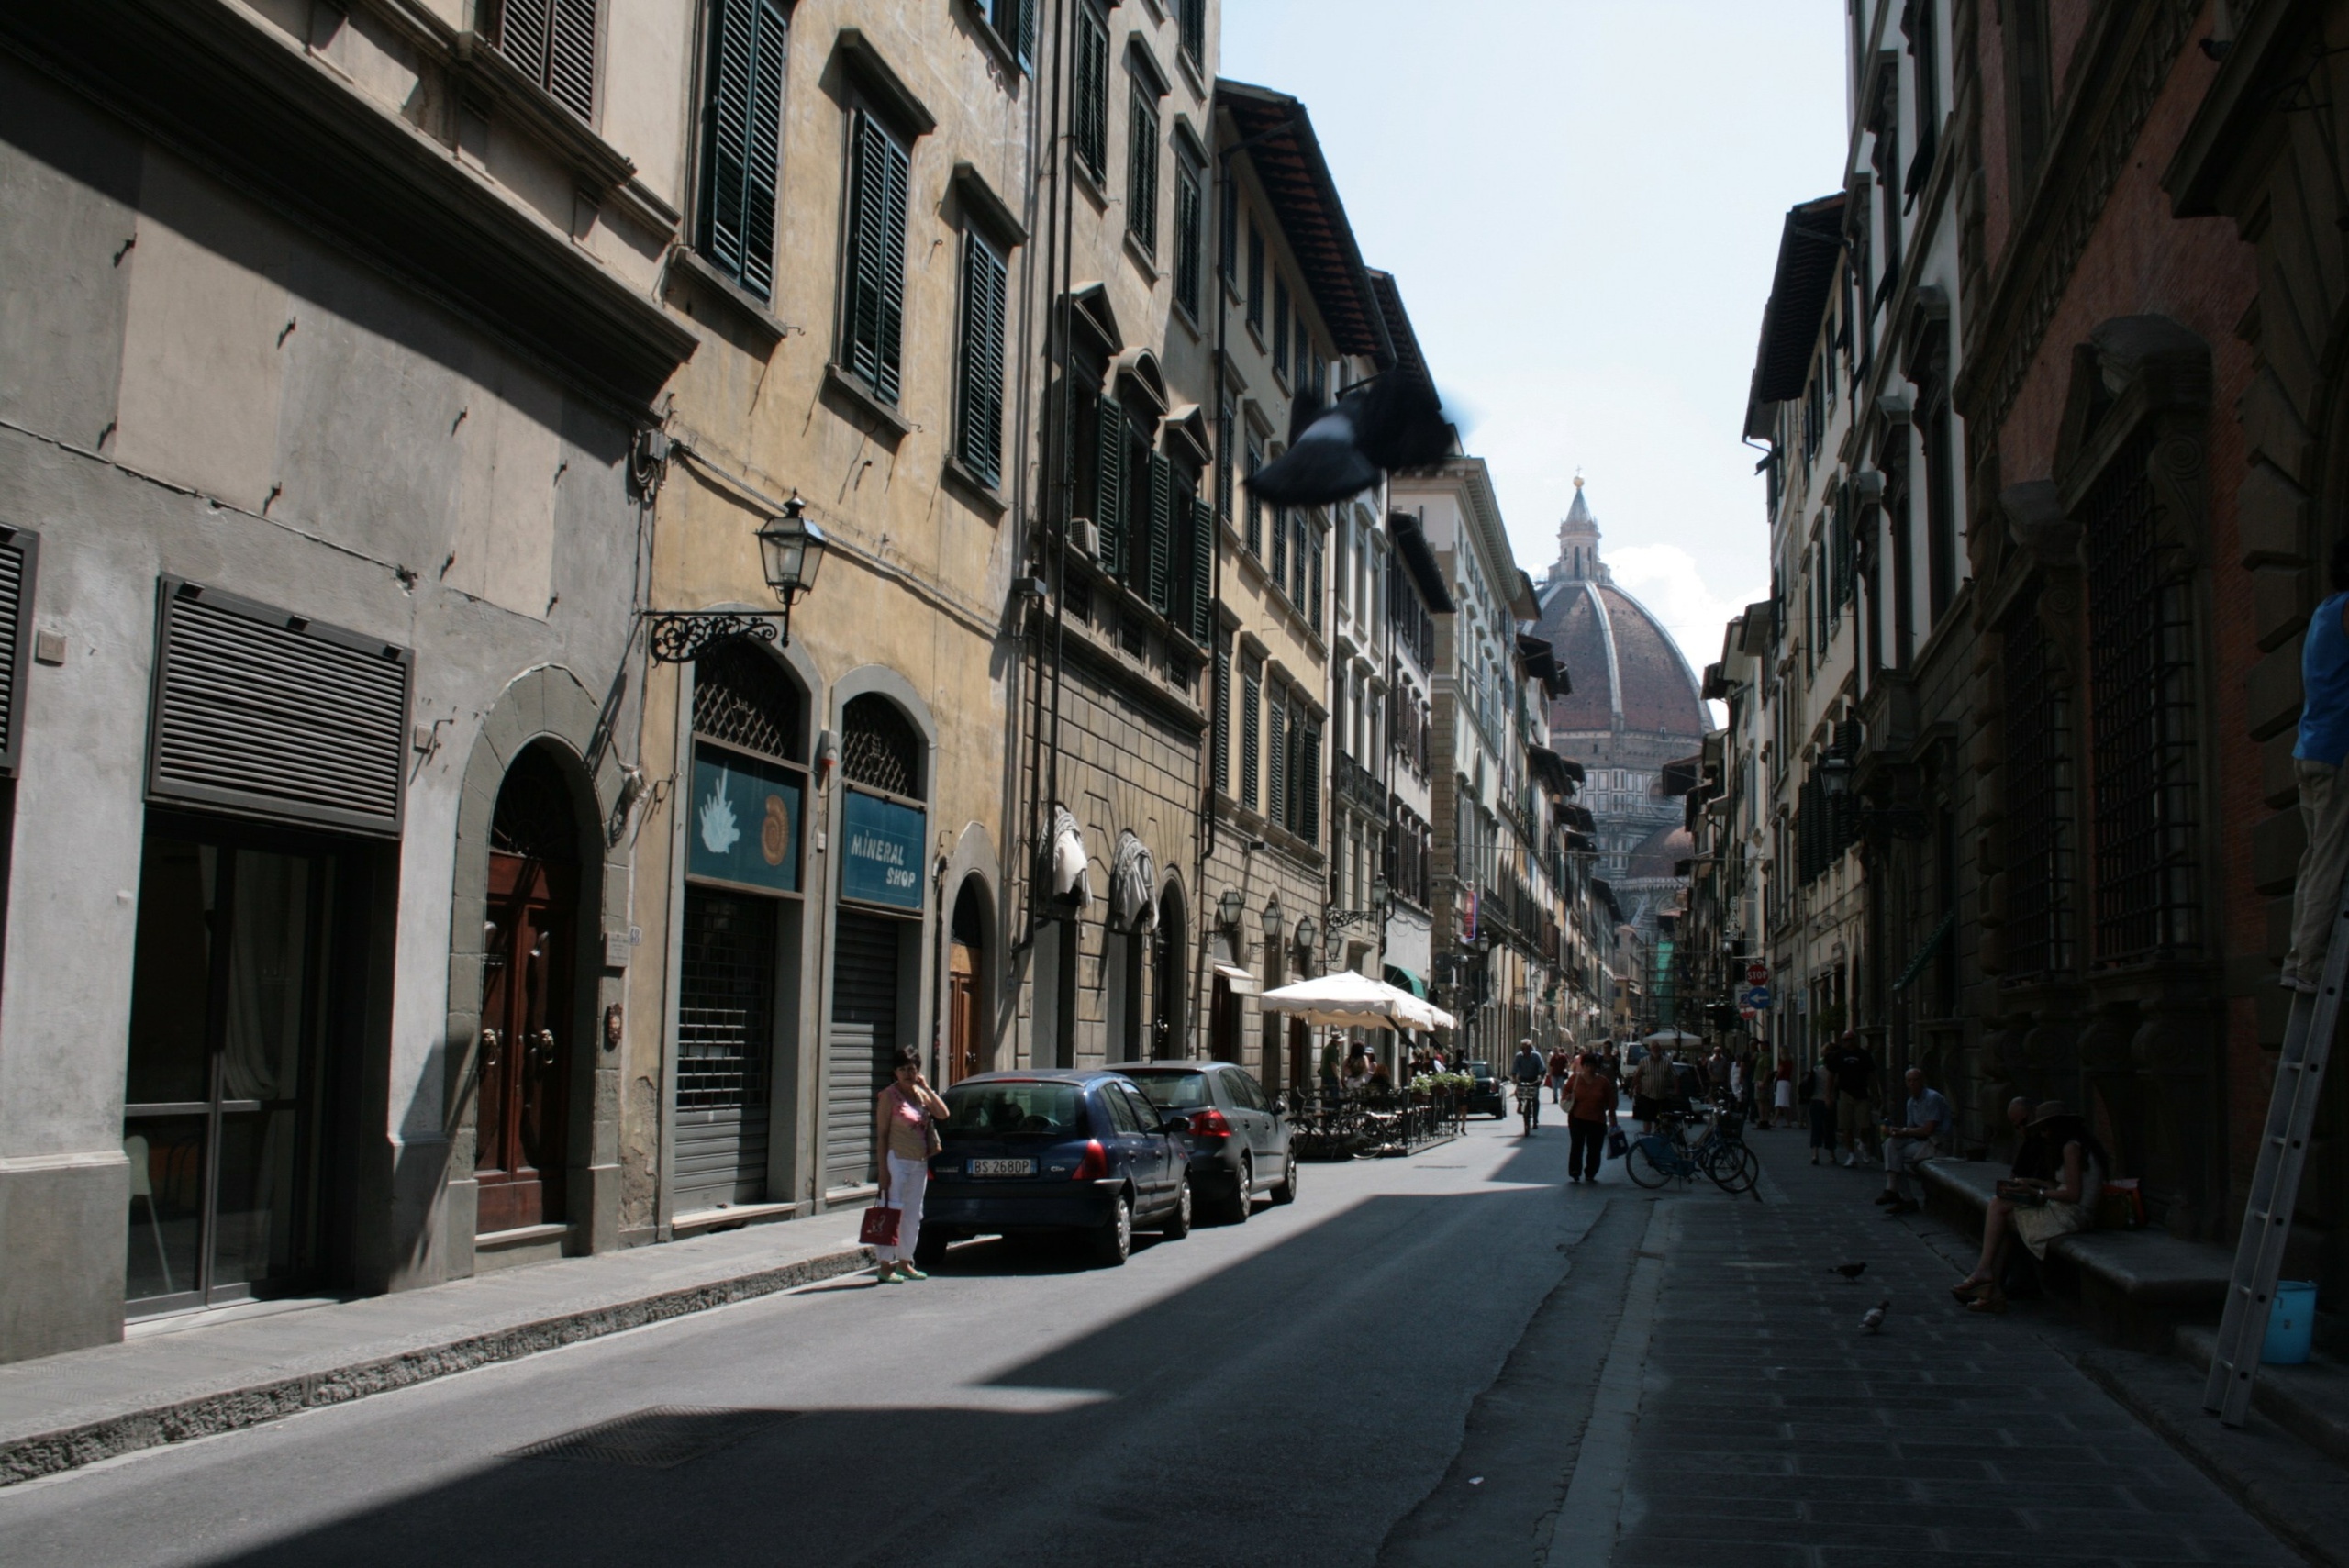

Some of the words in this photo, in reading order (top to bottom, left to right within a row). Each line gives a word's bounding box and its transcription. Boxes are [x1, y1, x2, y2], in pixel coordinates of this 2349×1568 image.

[886, 867, 915, 888] SHOP
[1747, 971, 1768, 981] STOP
[974, 1161, 988, 1173] BS
[993, 1161, 1029, 1173] 268DP
